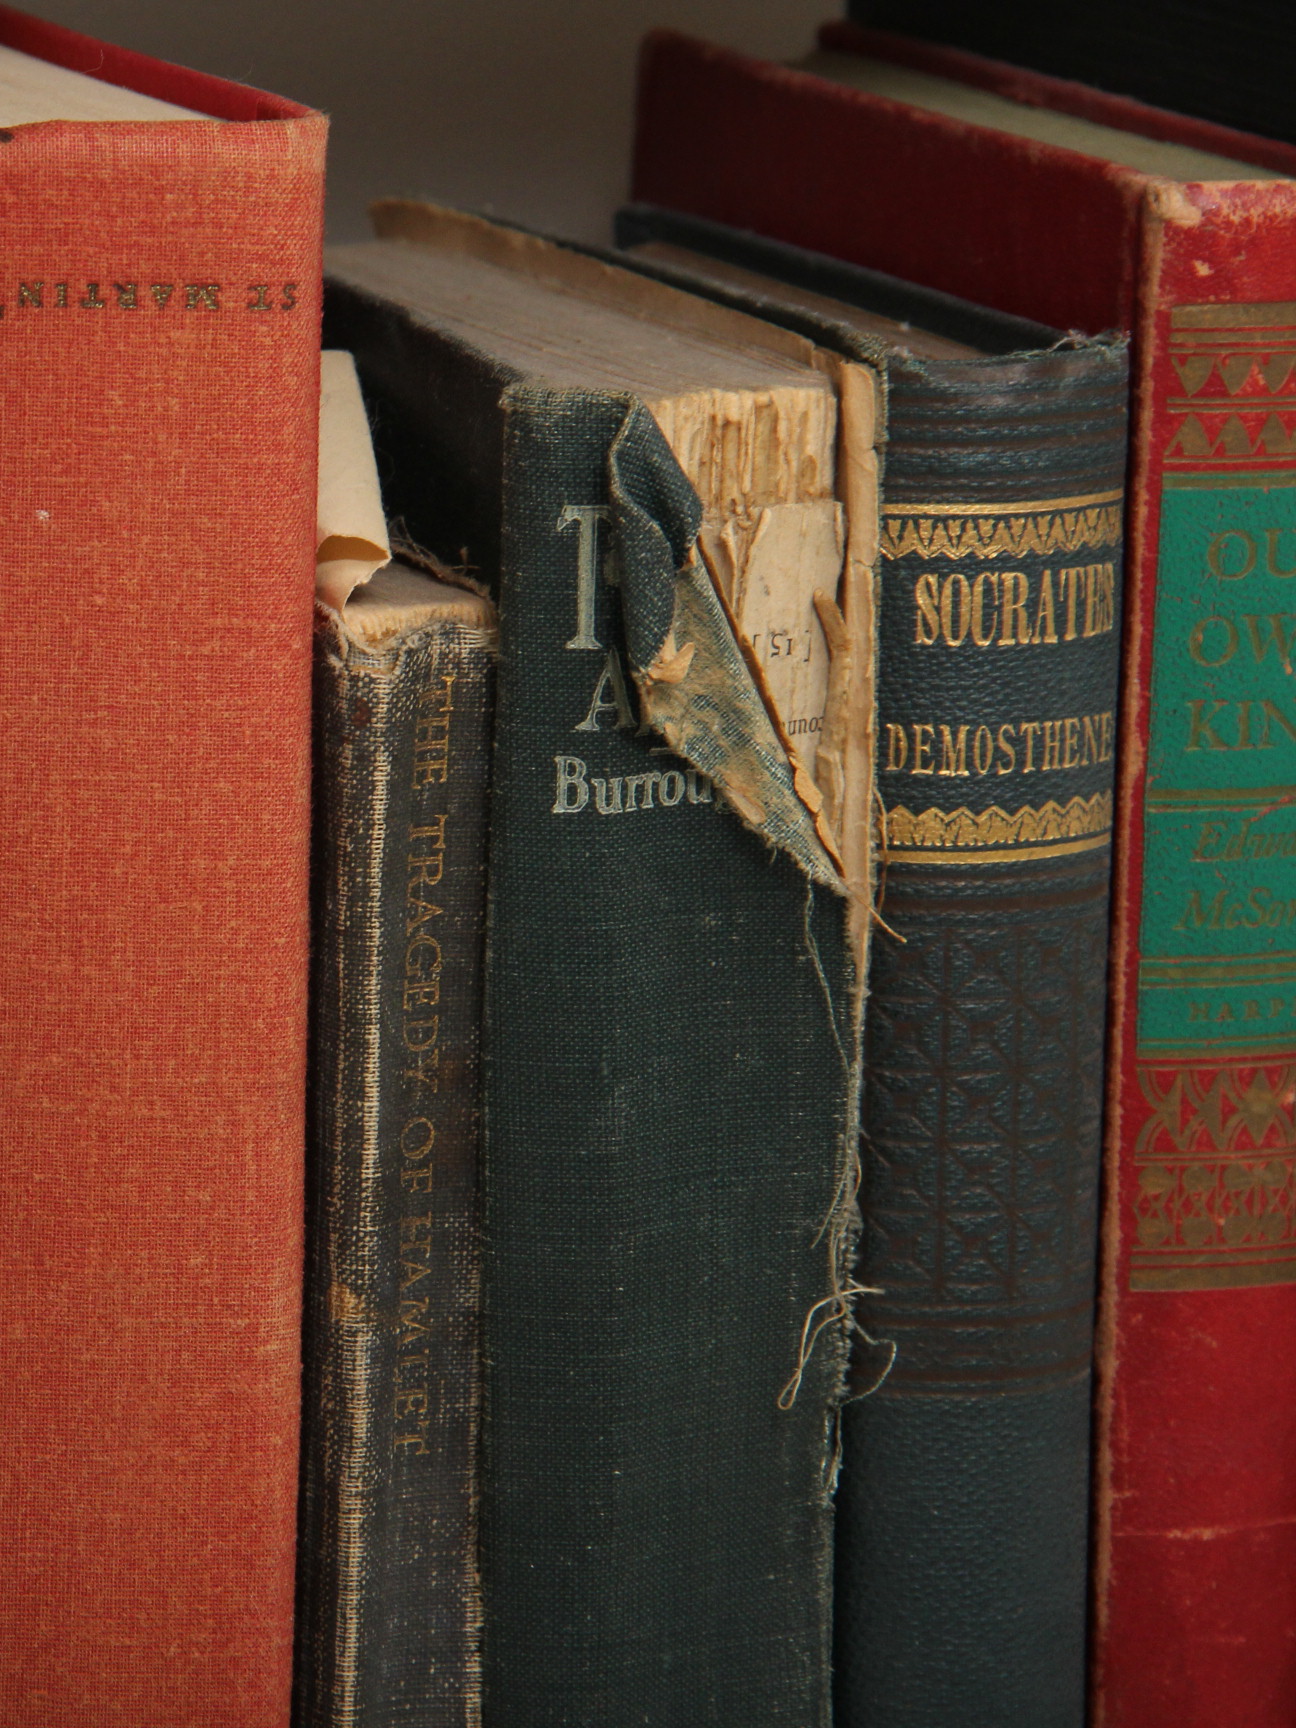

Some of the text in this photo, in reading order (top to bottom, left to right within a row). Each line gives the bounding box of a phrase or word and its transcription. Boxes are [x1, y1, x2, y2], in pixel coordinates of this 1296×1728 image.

[394, 675, 455, 1456] THE TRAGEDY OF HAMLET
[1188, 996, 1296, 1022] HARP
